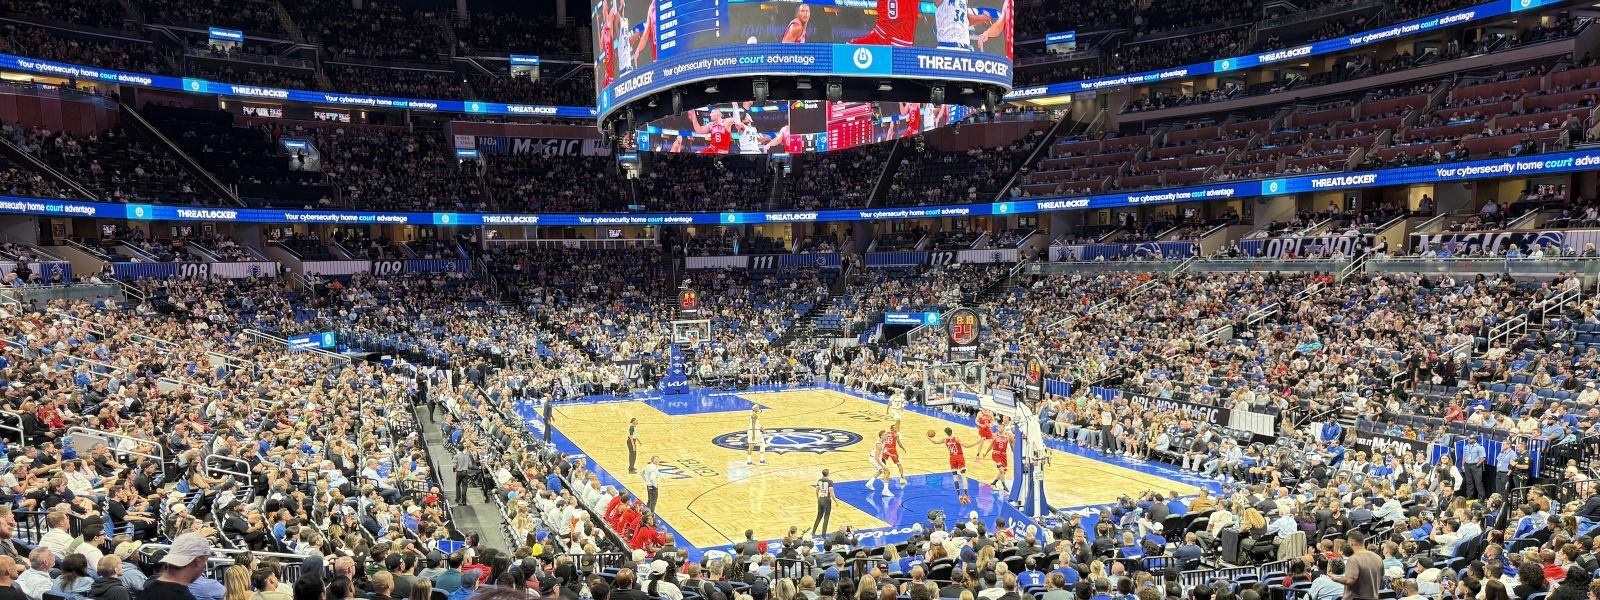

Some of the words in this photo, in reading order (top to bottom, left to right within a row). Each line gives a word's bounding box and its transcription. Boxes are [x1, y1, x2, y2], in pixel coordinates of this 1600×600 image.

[1363, 28, 1401, 42] cybersecurity
[1402, 24, 1419, 32] home
[1420, 19, 1438, 28] court
[1440, 12, 1475, 24] advantage
[1259, 47, 1313, 62] THREATLOCKER
[18, 60, 34, 68] Your
[35, 63, 79, 76] cybersecurity
[81, 68, 99, 77] home
[119, 75, 151, 85] advantage
[662, 67, 674, 77] Your
[673, 59, 712, 76] cybersecurity
[713, 56, 737, 66] home
[739, 54, 765, 64] court
[767, 54, 815, 65] advantage
[917, 55, 1009, 76] THREATLOCKER
[614, 71, 655, 98] THREATLOCKER
[1093, 78, 1127, 88] cybersecurity
[1144, 73, 1159, 81] court
[1160, 70, 1187, 79] advantage
[231, 87, 289, 97] THREATLOCKER
[325, 95, 338, 103] Your
[339, 97, 375, 106] cybersecurity
[409, 101, 437, 109] advantage
[507, 106, 558, 114] THREATLOCKER
[1437, 168, 1456, 177] Your
[1457, 163, 1515, 177] cybersecurity
[1517, 162, 1543, 170] home
[1545, 158, 1573, 168] court
[1575, 155, 1600, 165] adva
[1312, 174, 1377, 188] THREATLOCKER
[1037, 200, 1090, 210] THREATLOCKER
[1140, 193, 1176, 203] cybersecurity
[27, 202, 45, 211] home
[65, 205, 95, 215] advantage
[177, 209, 237, 219] THREATLOCKER
[873, 211, 908, 219] cybersecurity
[300, 213, 339, 222] cybersecurity
[377, 215, 407, 223] advantage
[765, 213, 818, 221] THREATLOCKER
[753, 256, 773, 268] 111
[930, 252, 953, 265] 112
[180, 263, 208, 280] 108
[374, 261, 402, 276] 109
[956, 316, 974, 325] 8:18
[954, 325, 972, 341] 24
